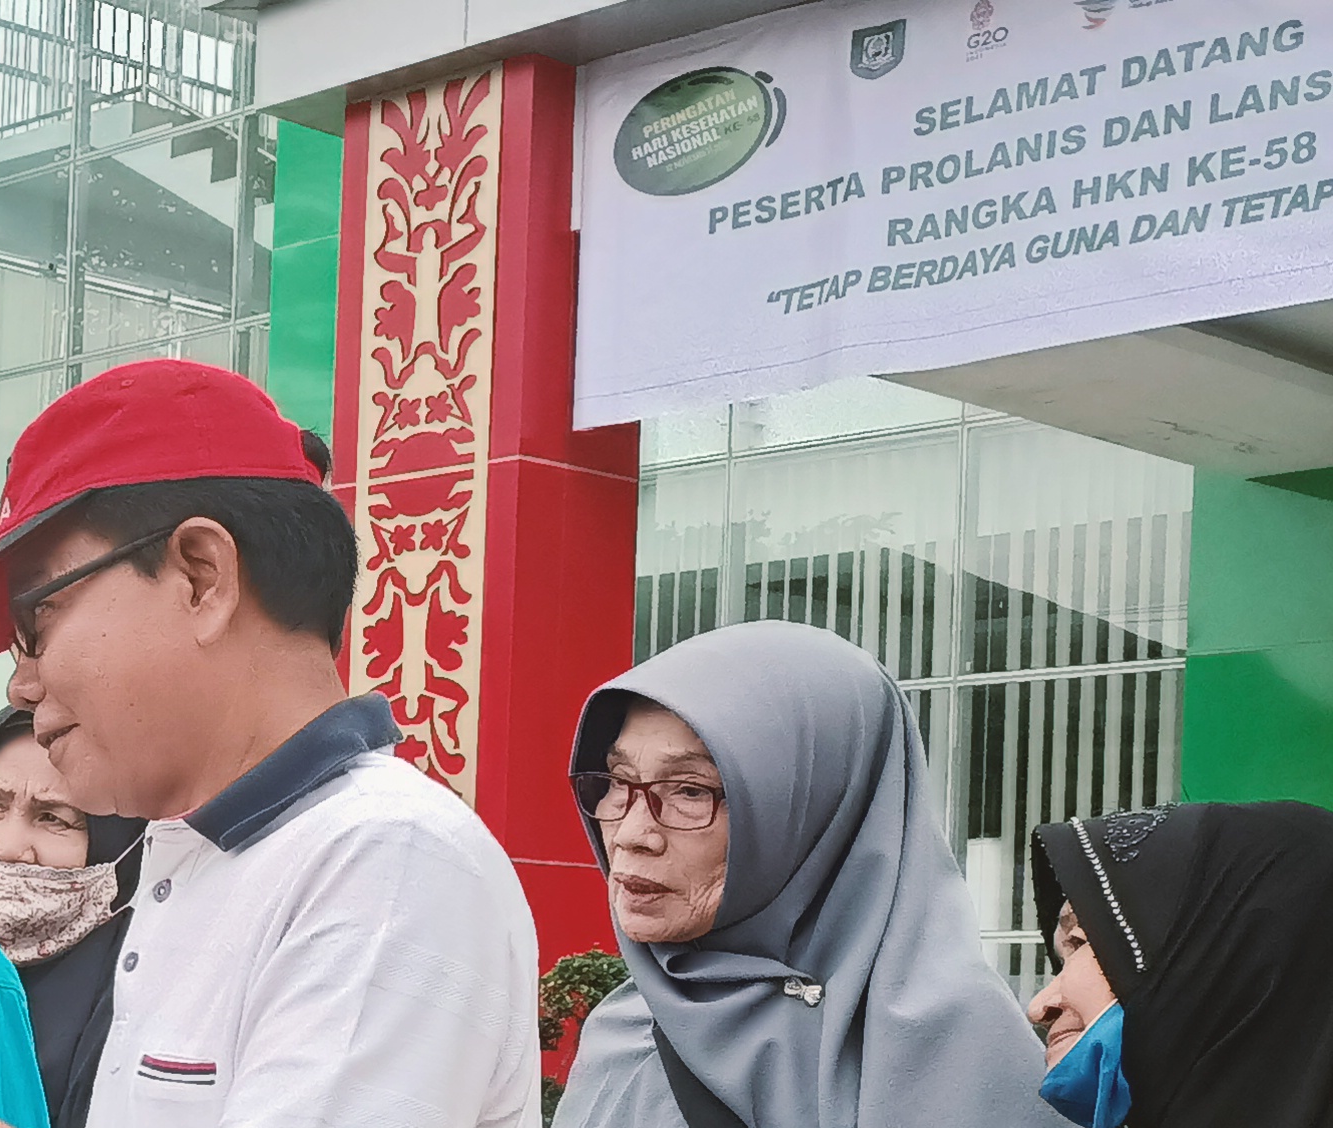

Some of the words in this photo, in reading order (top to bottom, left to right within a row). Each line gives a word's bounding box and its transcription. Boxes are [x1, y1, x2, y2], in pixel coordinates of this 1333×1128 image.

[914, 64, 1106, 136] SELAMAT
[1121, 19, 1304, 88] DATANG
[966, 26, 1009, 49] G20
[631, 134, 669, 160] HARI
[671, 95, 758, 143] KESEHATAN
[643, 88, 737, 138] PERINGATAN
[645, 127, 721, 169] NASIONAL
[709, 172, 865, 234] PESERTA
[881, 125, 1086, 194] PROLANIS
[1103, 100, 1191, 148] DAN
[887, 186, 1057, 246] RANGKA
[1072, 162, 1169, 209] HKN
[1187, 131, 1317, 187] KE-58
[867, 242, 1016, 293] BERDAYA
[1025, 220, 1119, 264] GUNA
[1129, 203, 1211, 245] DAN
[1222, 178, 1333, 227] TETAP
